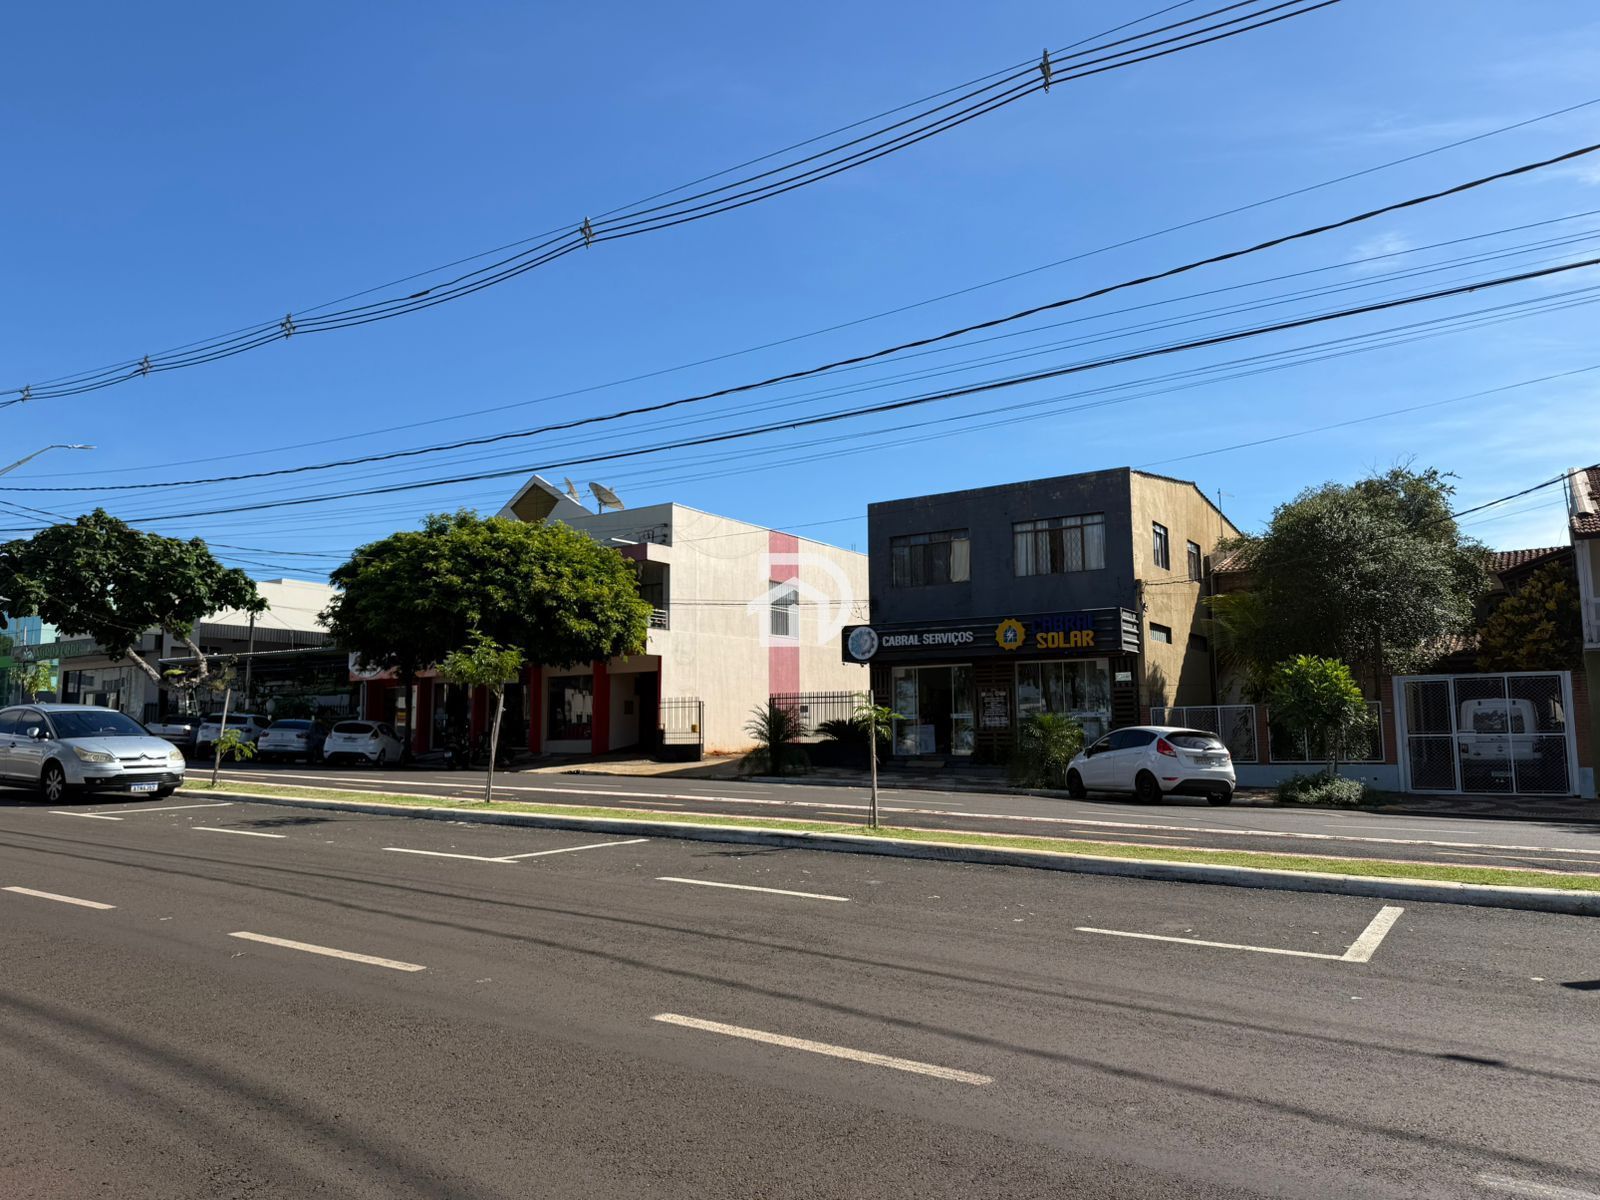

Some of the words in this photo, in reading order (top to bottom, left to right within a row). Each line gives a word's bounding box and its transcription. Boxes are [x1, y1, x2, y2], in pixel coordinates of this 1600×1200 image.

[1032, 613, 1094, 632] CABRAL
[882, 634, 921, 647] CABRAL
[922, 631, 974, 646] SERVIÇOS
[1036, 630, 1095, 649] SOLAR
